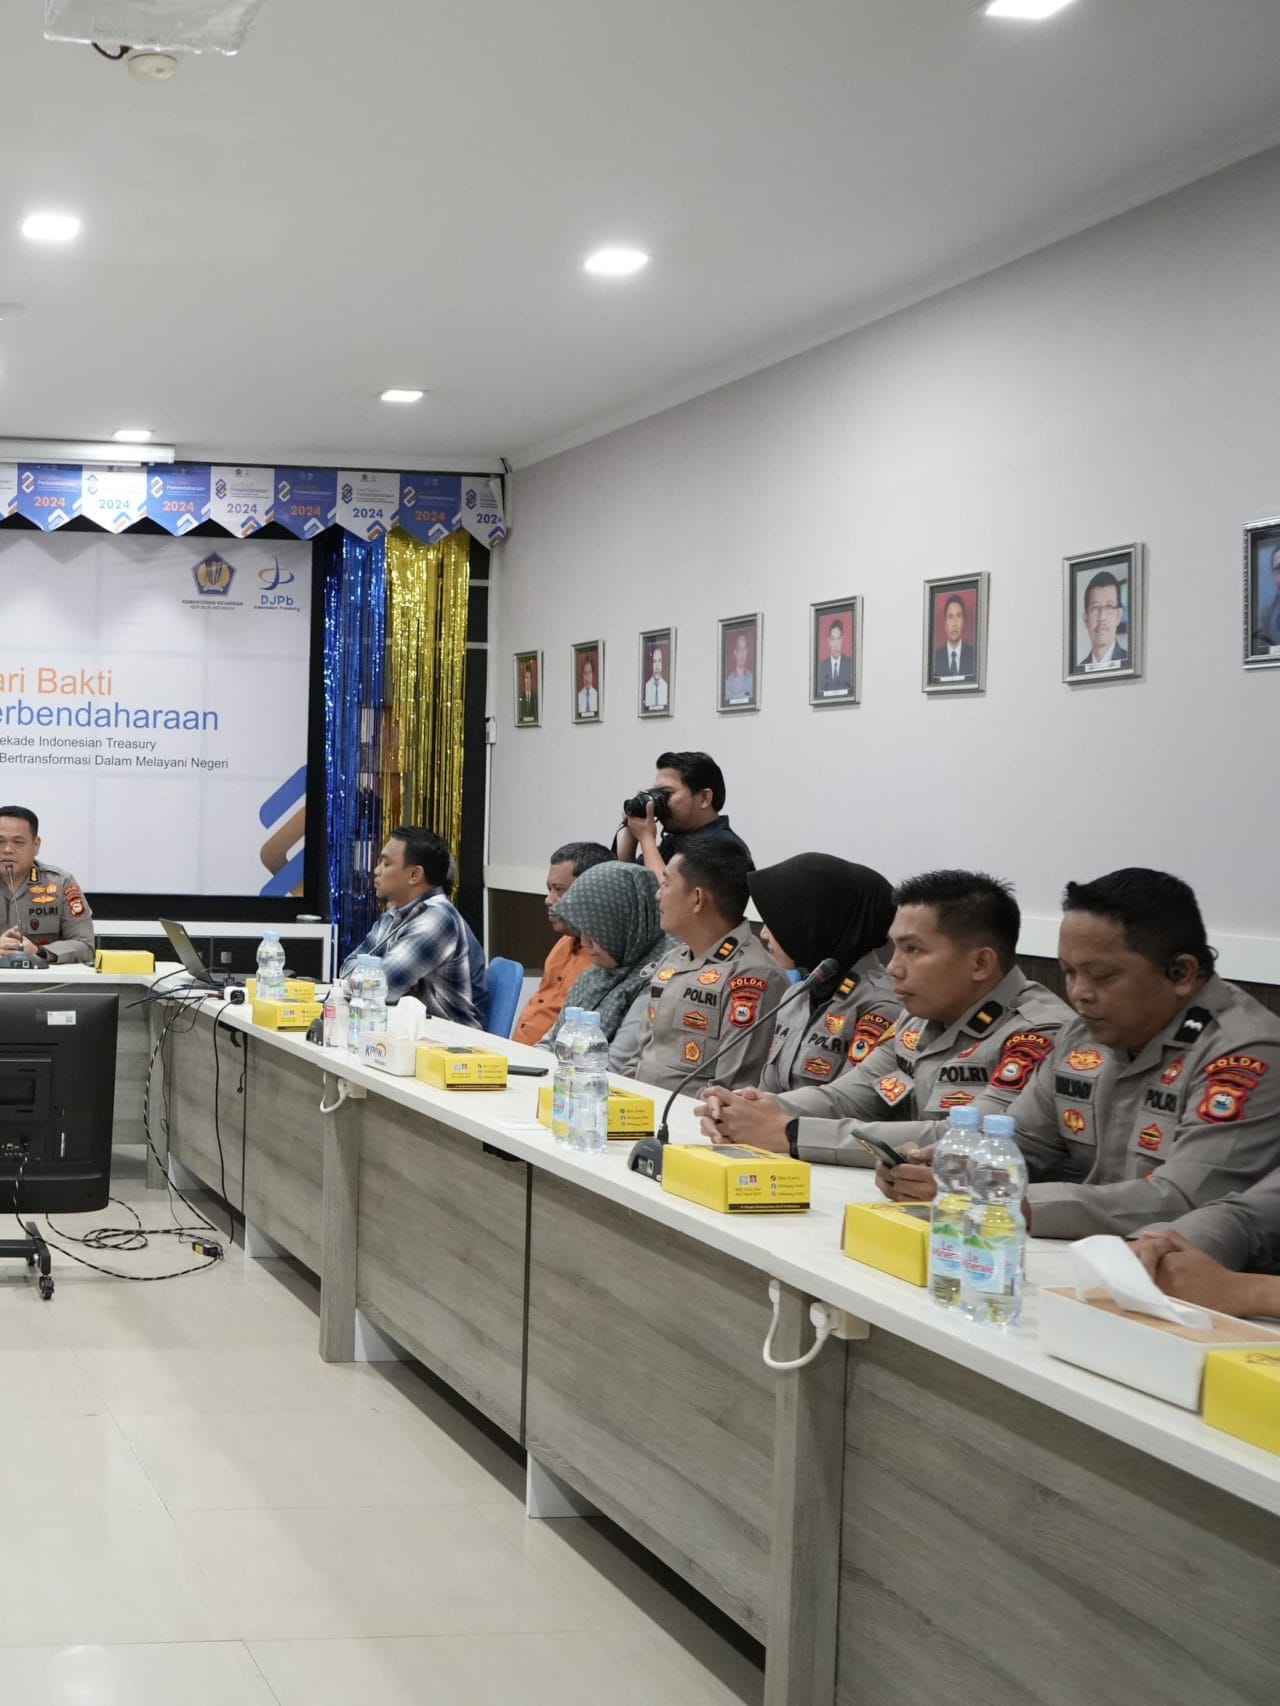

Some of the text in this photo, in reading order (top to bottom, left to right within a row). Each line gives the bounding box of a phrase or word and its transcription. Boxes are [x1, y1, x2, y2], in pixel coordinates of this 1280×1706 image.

[34, 496, 66, 508] 2024
[98, 498, 130, 510] 2024
[163, 500, 195, 513] 2024
[226, 502, 258, 514] 2024
[290, 504, 321, 516] 2024
[352, 507, 384, 519] 2024
[415, 511, 446, 522] 2024
[261, 594, 294, 606] DJPb
[37, 667, 113, 696] Bakti
[39, 736, 102, 749] Indonesian
[106, 737, 157, 752] Treasury
[0, 752, 91, 766] Bertransformasi
[95, 755, 132, 767] Dalam
[135, 756, 187, 770] Melayani
[191, 757, 228, 771] Negeri
[28, 906, 58, 917] POLRI
[730, 977, 764, 990] POLDA
[683, 987, 717, 1007] POLRI
[863, 1013, 890, 1029] OLDA
[1006, 1034, 1045, 1048] POLDA
[1207, 1056, 1262, 1071] POLDA
[938, 1066, 989, 1083] POLRI
[1144, 1088, 1178, 1113] POLRI
[967, 1250, 980, 1263] Le
